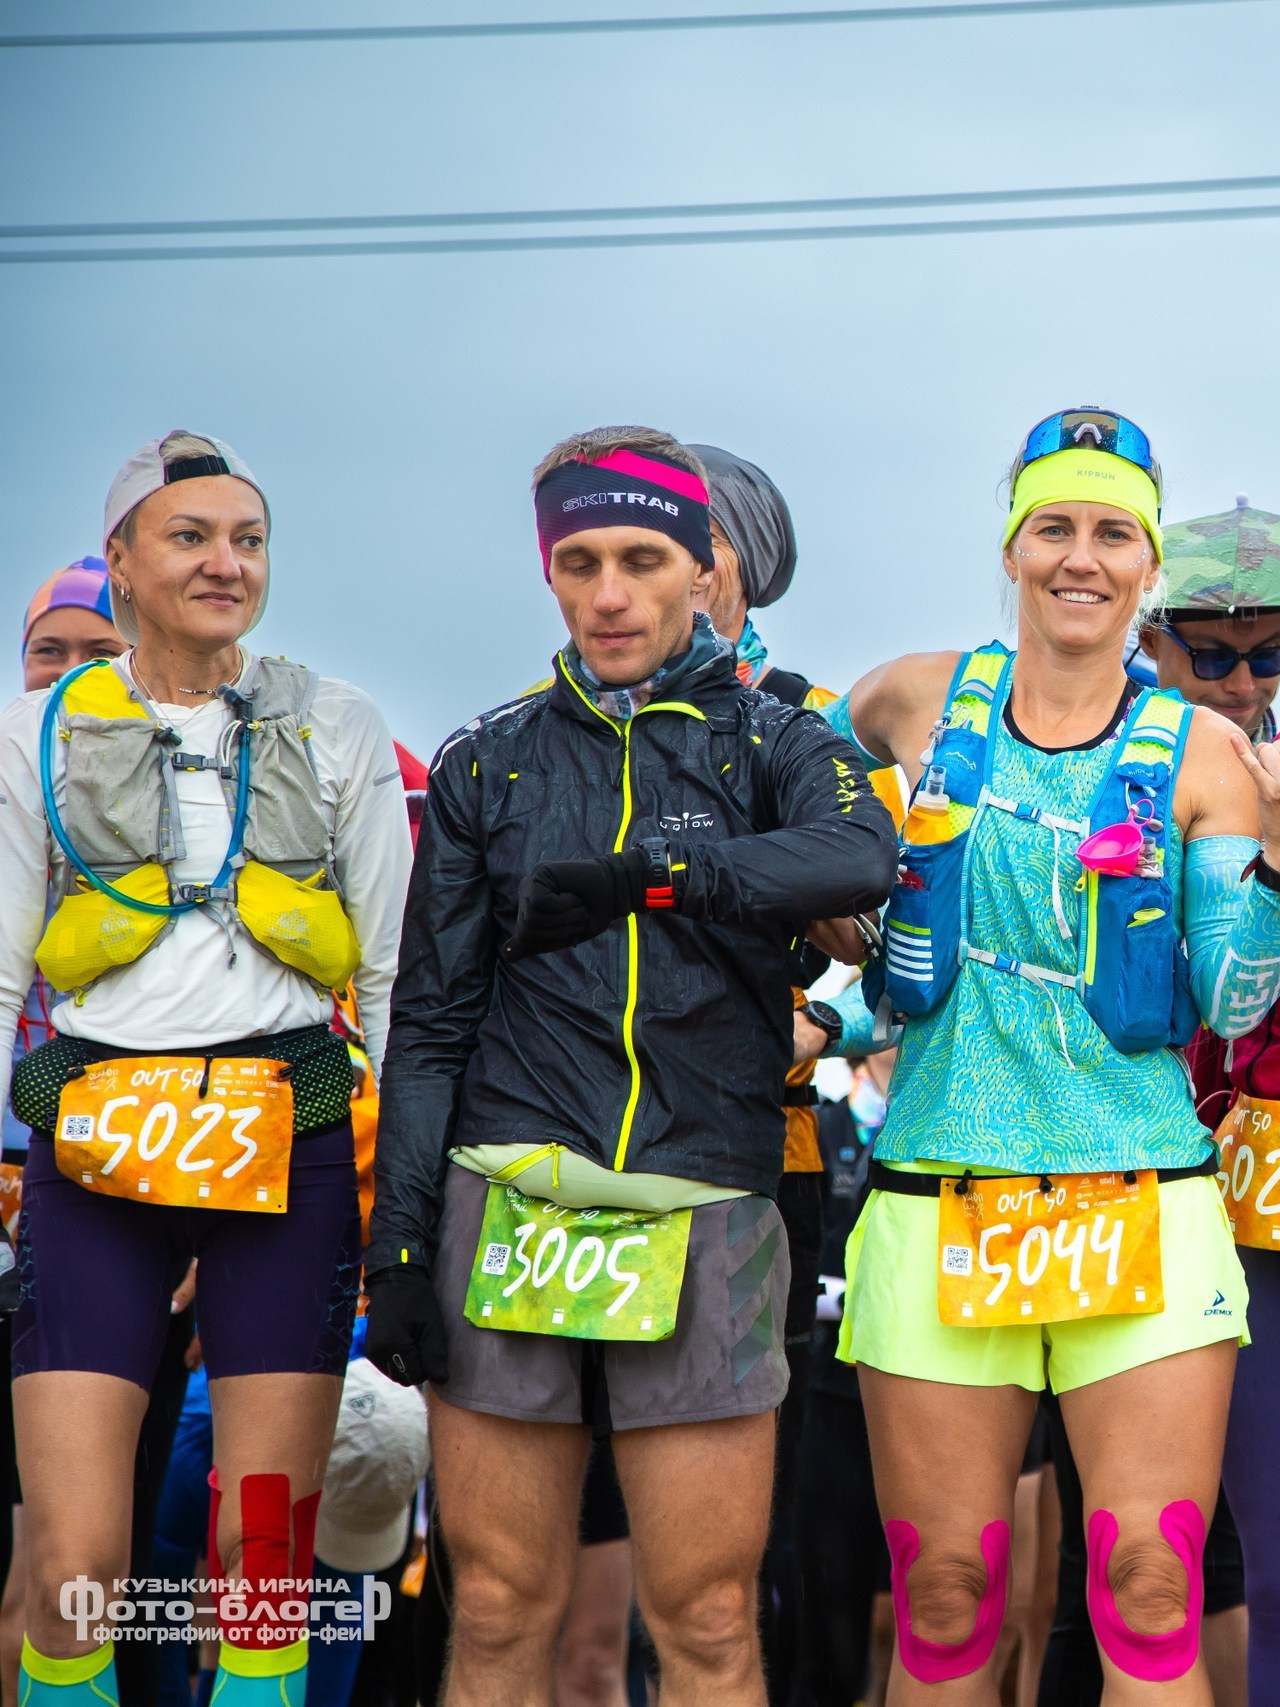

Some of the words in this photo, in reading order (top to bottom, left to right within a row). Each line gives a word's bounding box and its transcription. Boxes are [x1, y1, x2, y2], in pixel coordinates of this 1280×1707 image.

[1076, 469, 1115, 480] KIPRUN
[130, 1066, 179, 1093] OUT
[179, 1067, 207, 1092] 50
[1251, 1110, 1273, 1135] 50
[96, 1095, 263, 1180] 5023
[997, 1188, 1041, 1217] OUT
[1043, 1187, 1067, 1213] 50
[501, 1222, 649, 1317] 3005
[978, 1213, 1125, 1306] 5044
[1203, 1308, 1233, 1317] DEMIX
